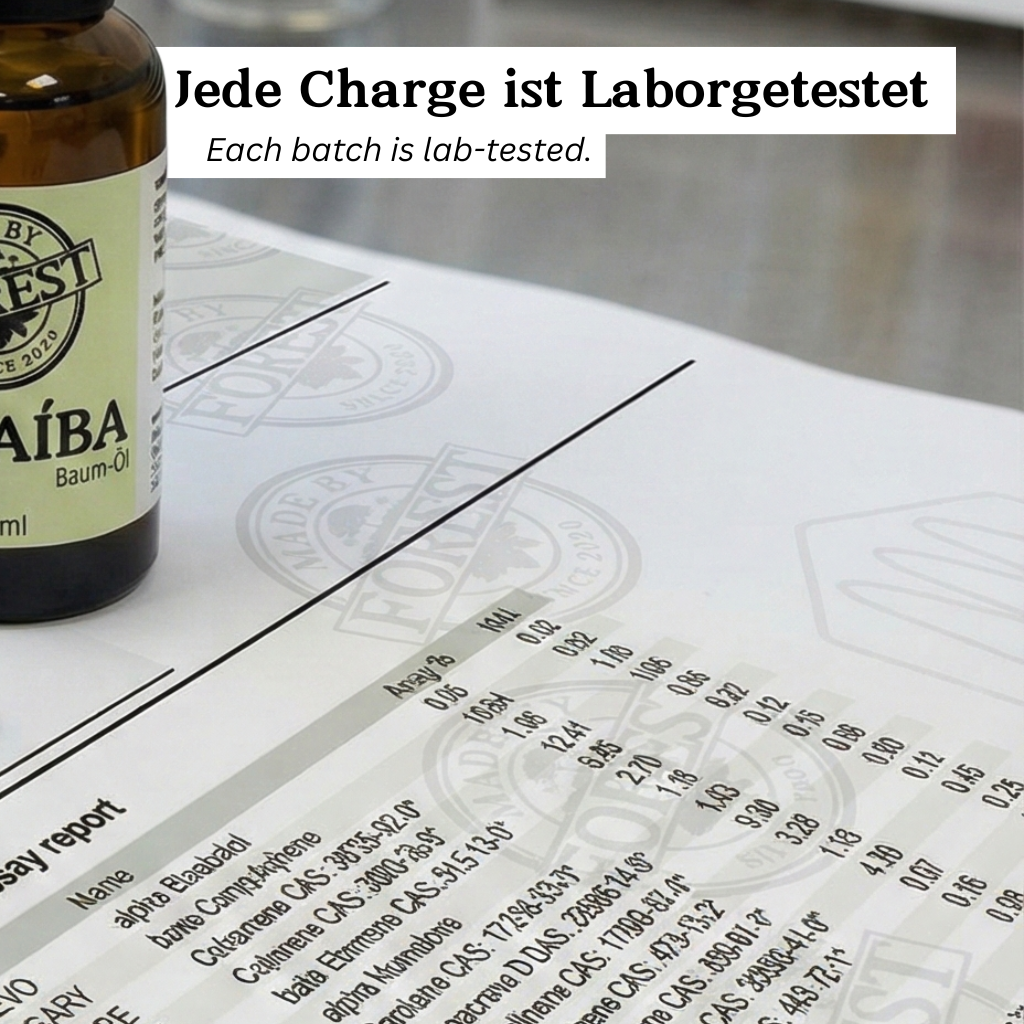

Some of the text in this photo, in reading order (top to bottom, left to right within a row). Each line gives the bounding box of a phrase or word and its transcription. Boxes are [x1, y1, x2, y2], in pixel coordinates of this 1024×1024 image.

[4, 219, 43, 247] BY
[21, 328, 59, 367] 2020
[56, 447, 130, 488] Baum-Öl
[902, 749, 946, 780] 0.12
[38, 797, 128, 855] report
[66, 868, 136, 911] Name
[440, 942, 496, 977] CAS:
[559, 949, 612, 990] CAS:
